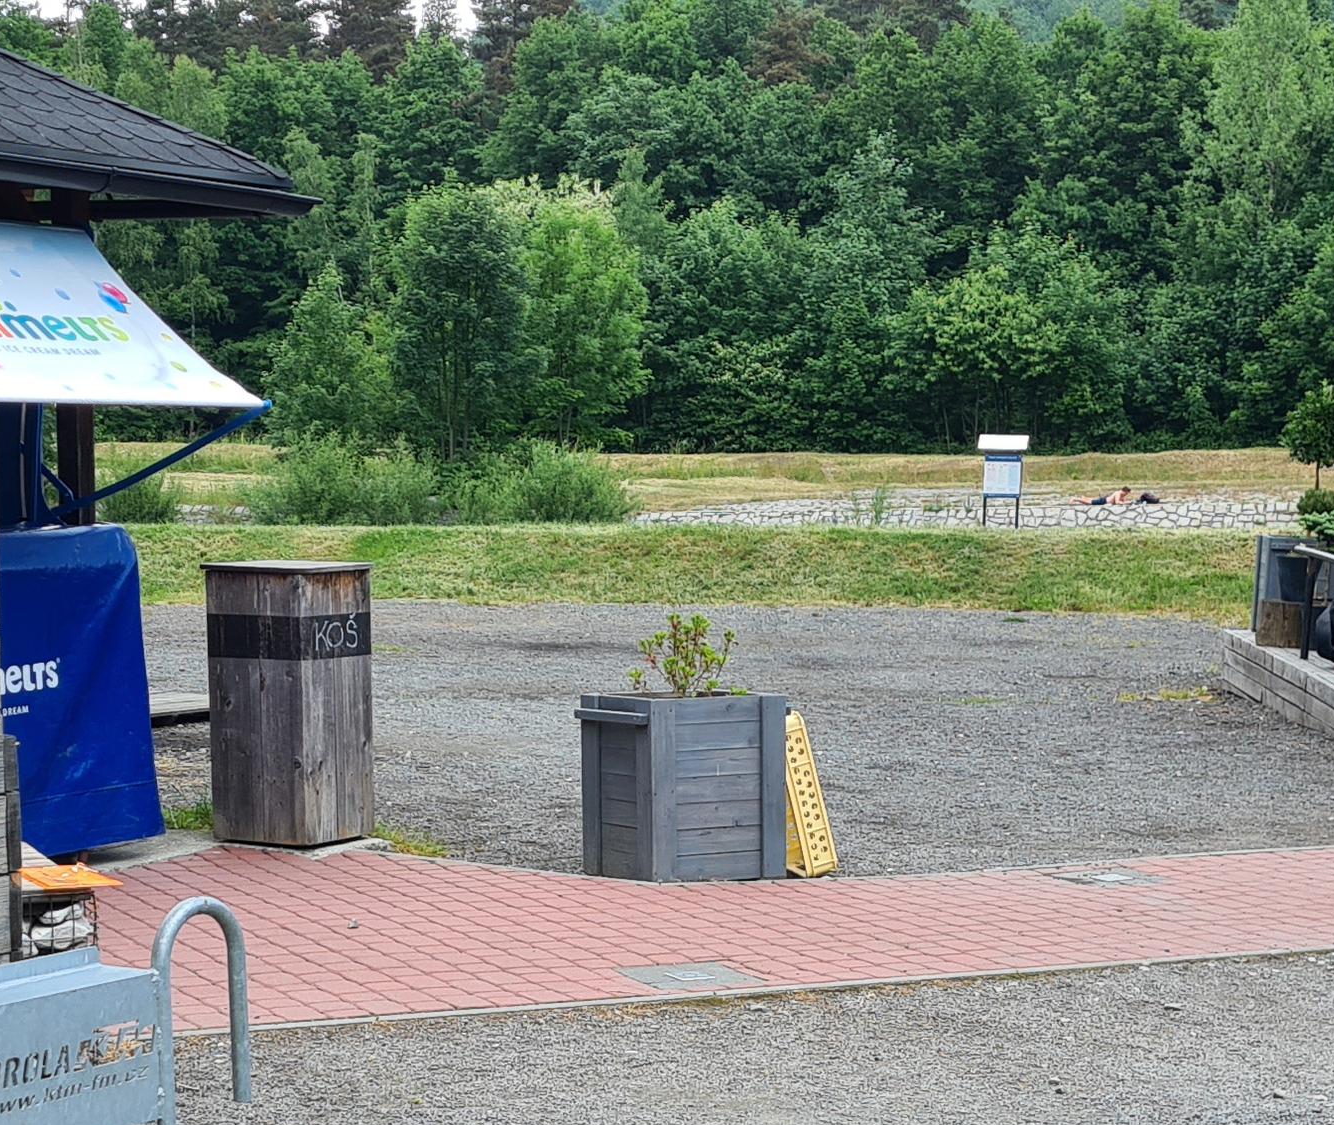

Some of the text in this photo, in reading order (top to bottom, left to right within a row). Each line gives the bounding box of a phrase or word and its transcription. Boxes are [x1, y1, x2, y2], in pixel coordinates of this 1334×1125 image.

[315, 612, 358, 651] KOŠ
[2, 705, 30, 717] DREAM
[73, 1019, 157, 1073] KTM
